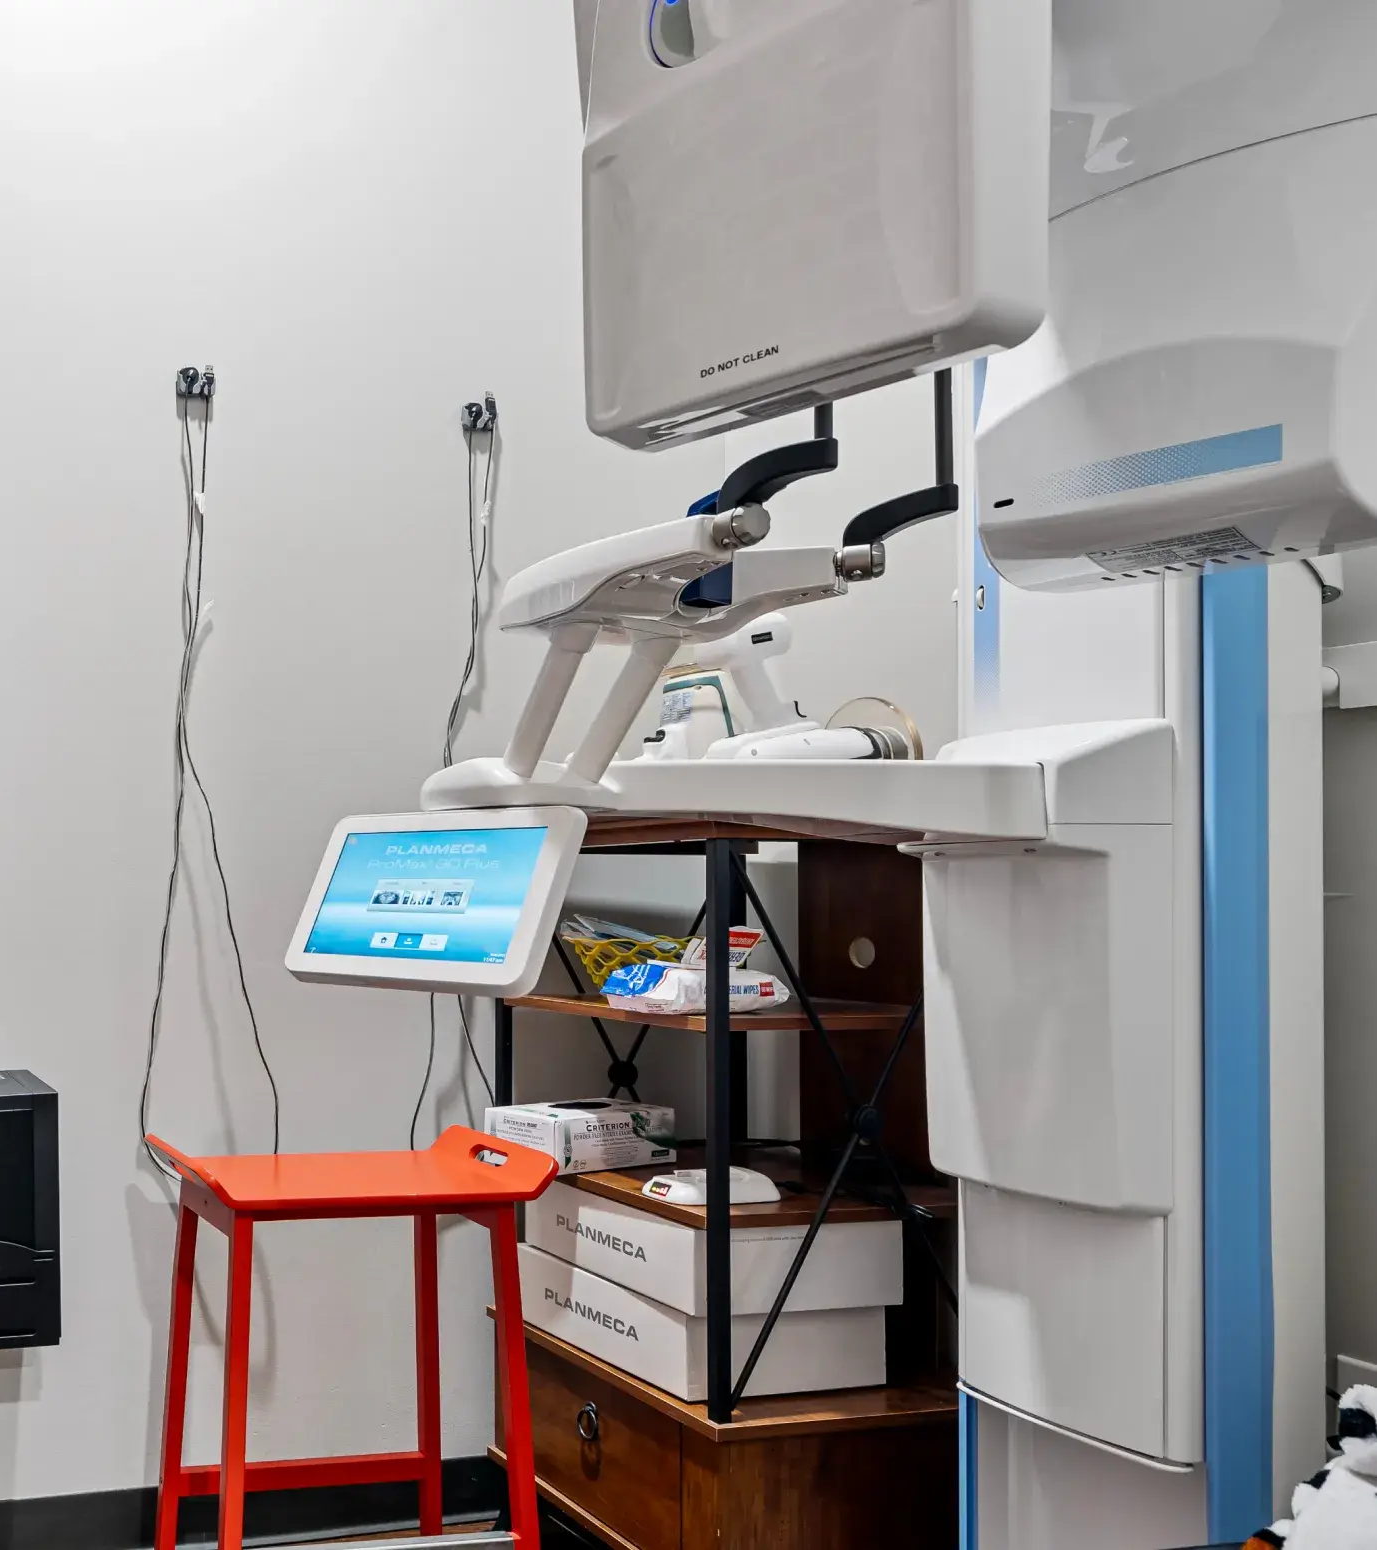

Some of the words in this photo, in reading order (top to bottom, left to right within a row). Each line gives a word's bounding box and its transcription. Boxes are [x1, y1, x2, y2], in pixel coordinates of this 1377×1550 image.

[700, 366, 715, 378] DO
[717, 357, 740, 372] NOT
[742, 345, 779, 364] CLEAN
[385, 843, 488, 856] PLANMECA
[464, 858, 500, 870] Plus
[743, 984, 759, 995] WIPES
[586, 1121, 630, 1132] CRITERION
[556, 1213, 647, 1262] PLANMECA
[544, 1287, 639, 1341] PLANMECA
